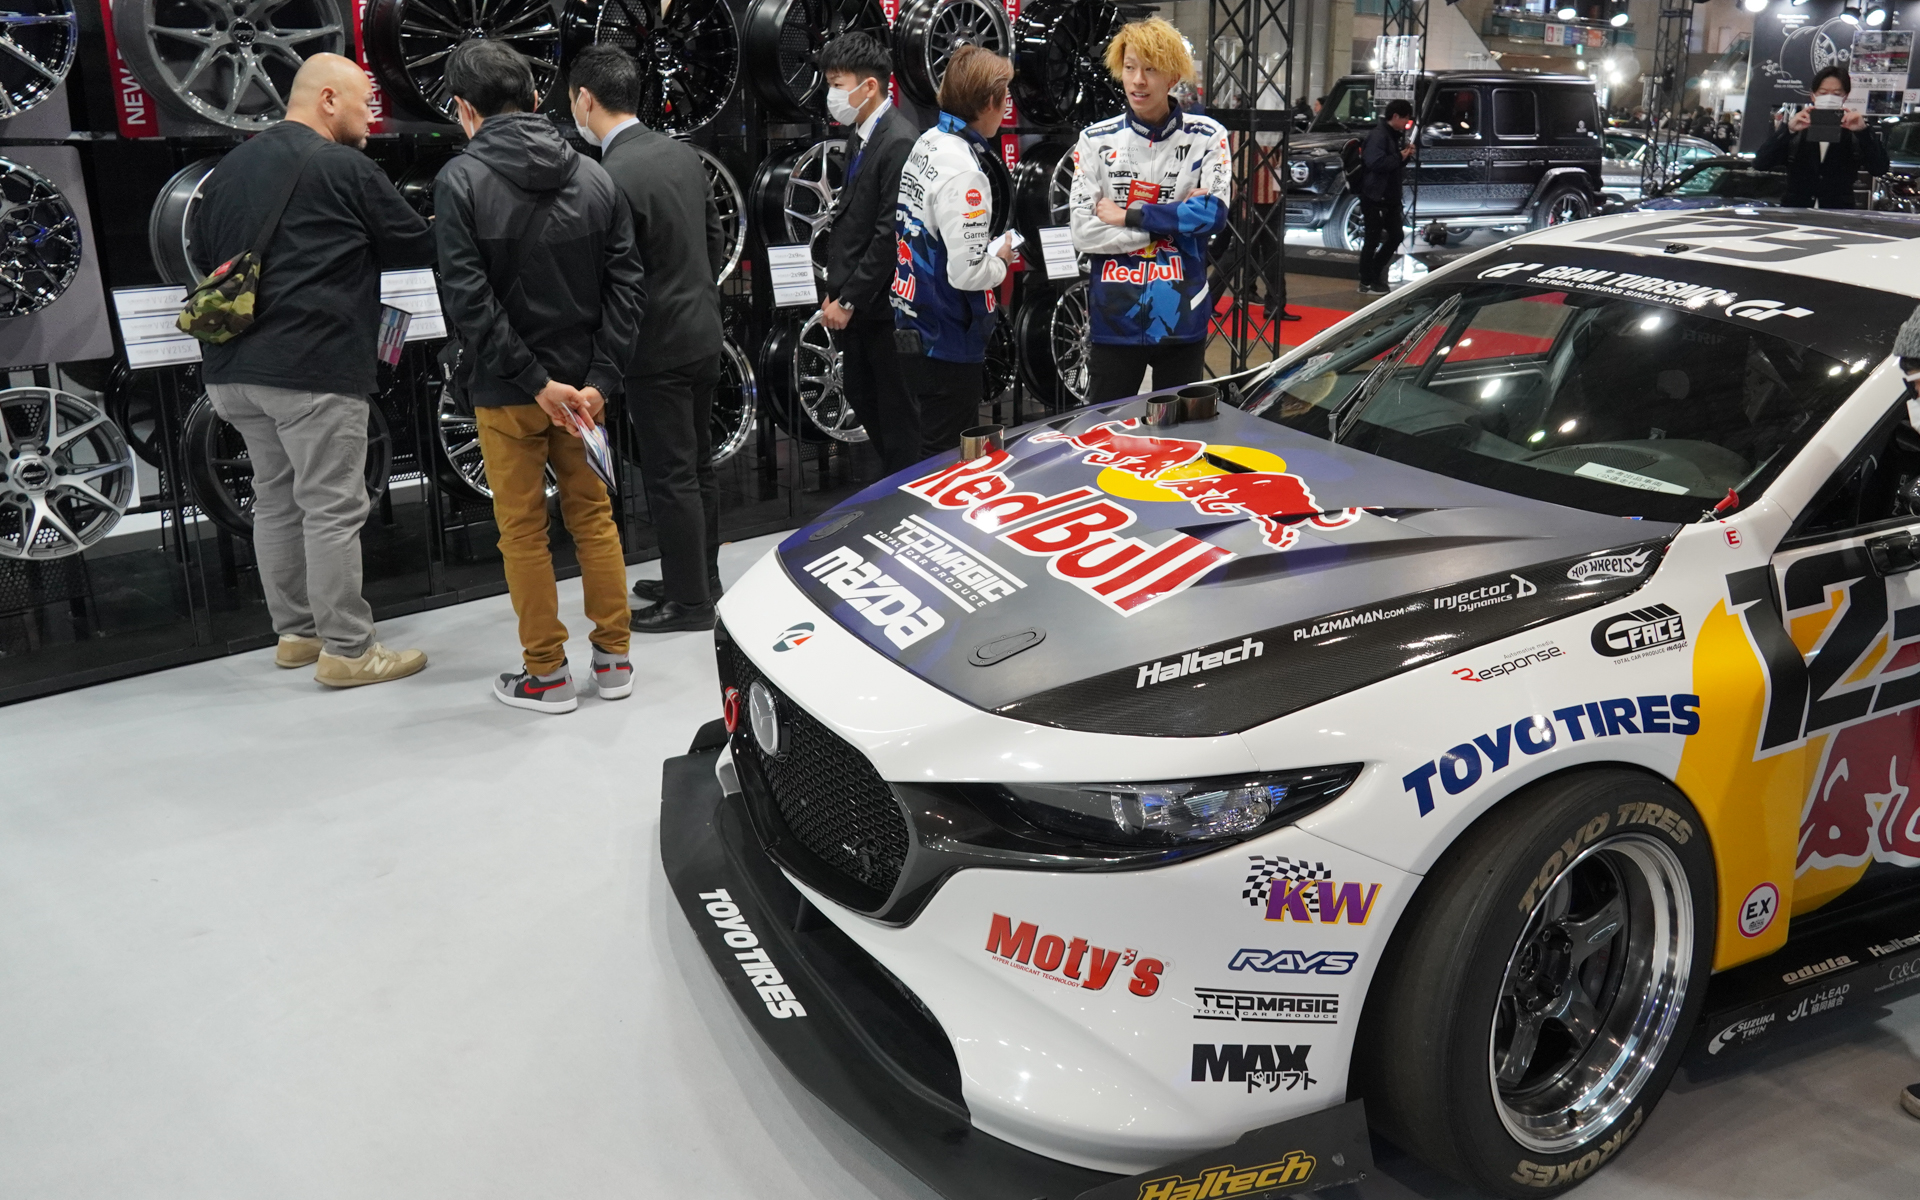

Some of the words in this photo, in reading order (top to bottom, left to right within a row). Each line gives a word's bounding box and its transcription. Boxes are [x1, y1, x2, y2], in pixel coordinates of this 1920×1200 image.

[964, 231, 988, 240] Garret
[1101, 259, 1147, 285] Red
[1537, 265, 1615, 285] GRAN
[1526, 277, 1549, 285] THE
[1547, 279, 1576, 288] REAL
[1576, 282, 1624, 295] DRIVING
[1623, 290, 1696, 308] SIMULATO
[900, 449, 1104, 533] Red
[1726, 530, 1740, 545] E
[875, 530, 901, 549] TOTAL
[905, 550, 926, 566] CAR
[930, 566, 987, 608] PRODUCE
[996, 498, 1237, 617] Bull
[1571, 564, 1588, 579] HOT
[1590, 557, 1635, 574] WHEELS
[803, 545, 946, 650] mazda
[1433, 581, 1511, 610] Injector
[1458, 593, 1513, 613] Dynamics
[1136, 637, 1264, 689] Haltech
[1503, 645, 1536, 660] Automotive
[1536, 639, 1554, 650] media
[1613, 656, 1631, 666] TOTAL
[1631, 653, 1642, 662] CAR
[1642, 647, 1665, 660] PRODUCE
[1666, 640, 1689, 653] magic
[1725, 545, 1920, 752] 12
[1402, 713, 1557, 818] TOYO
[1552, 693, 1700, 742] TIRES
[1518, 811, 1610, 914] TOYO
[1616, 802, 1694, 845] TIRES
[1264, 878, 1383, 926] KW
[1746, 897, 1771, 920] EX
[698, 888, 759, 948] TOYO
[734, 948, 808, 1019] TIRES
[985, 912, 1165, 997] Moty's
[1867, 931, 1920, 957] Haltec
[991, 955, 1010, 966] HYPER
[1010, 962, 1041, 976] LUBRICANT
[1042, 972, 1080, 988] TECHNOLOGY
[1228, 949, 1359, 975] RAYS
[1782, 955, 1852, 983] odula
[1810, 984, 1850, 1004] J-LEAD
[1736, 1013, 1775, 1033] SUZUKA
[1742, 1025, 1766, 1039] TWIN
[1191, 1043, 1312, 1082] MAX
[1247, 1071, 1318, 1094] ドリフト
[1510, 1105, 1643, 1188] PROXES
[1140, 1152, 1313, 1200] Haltech
